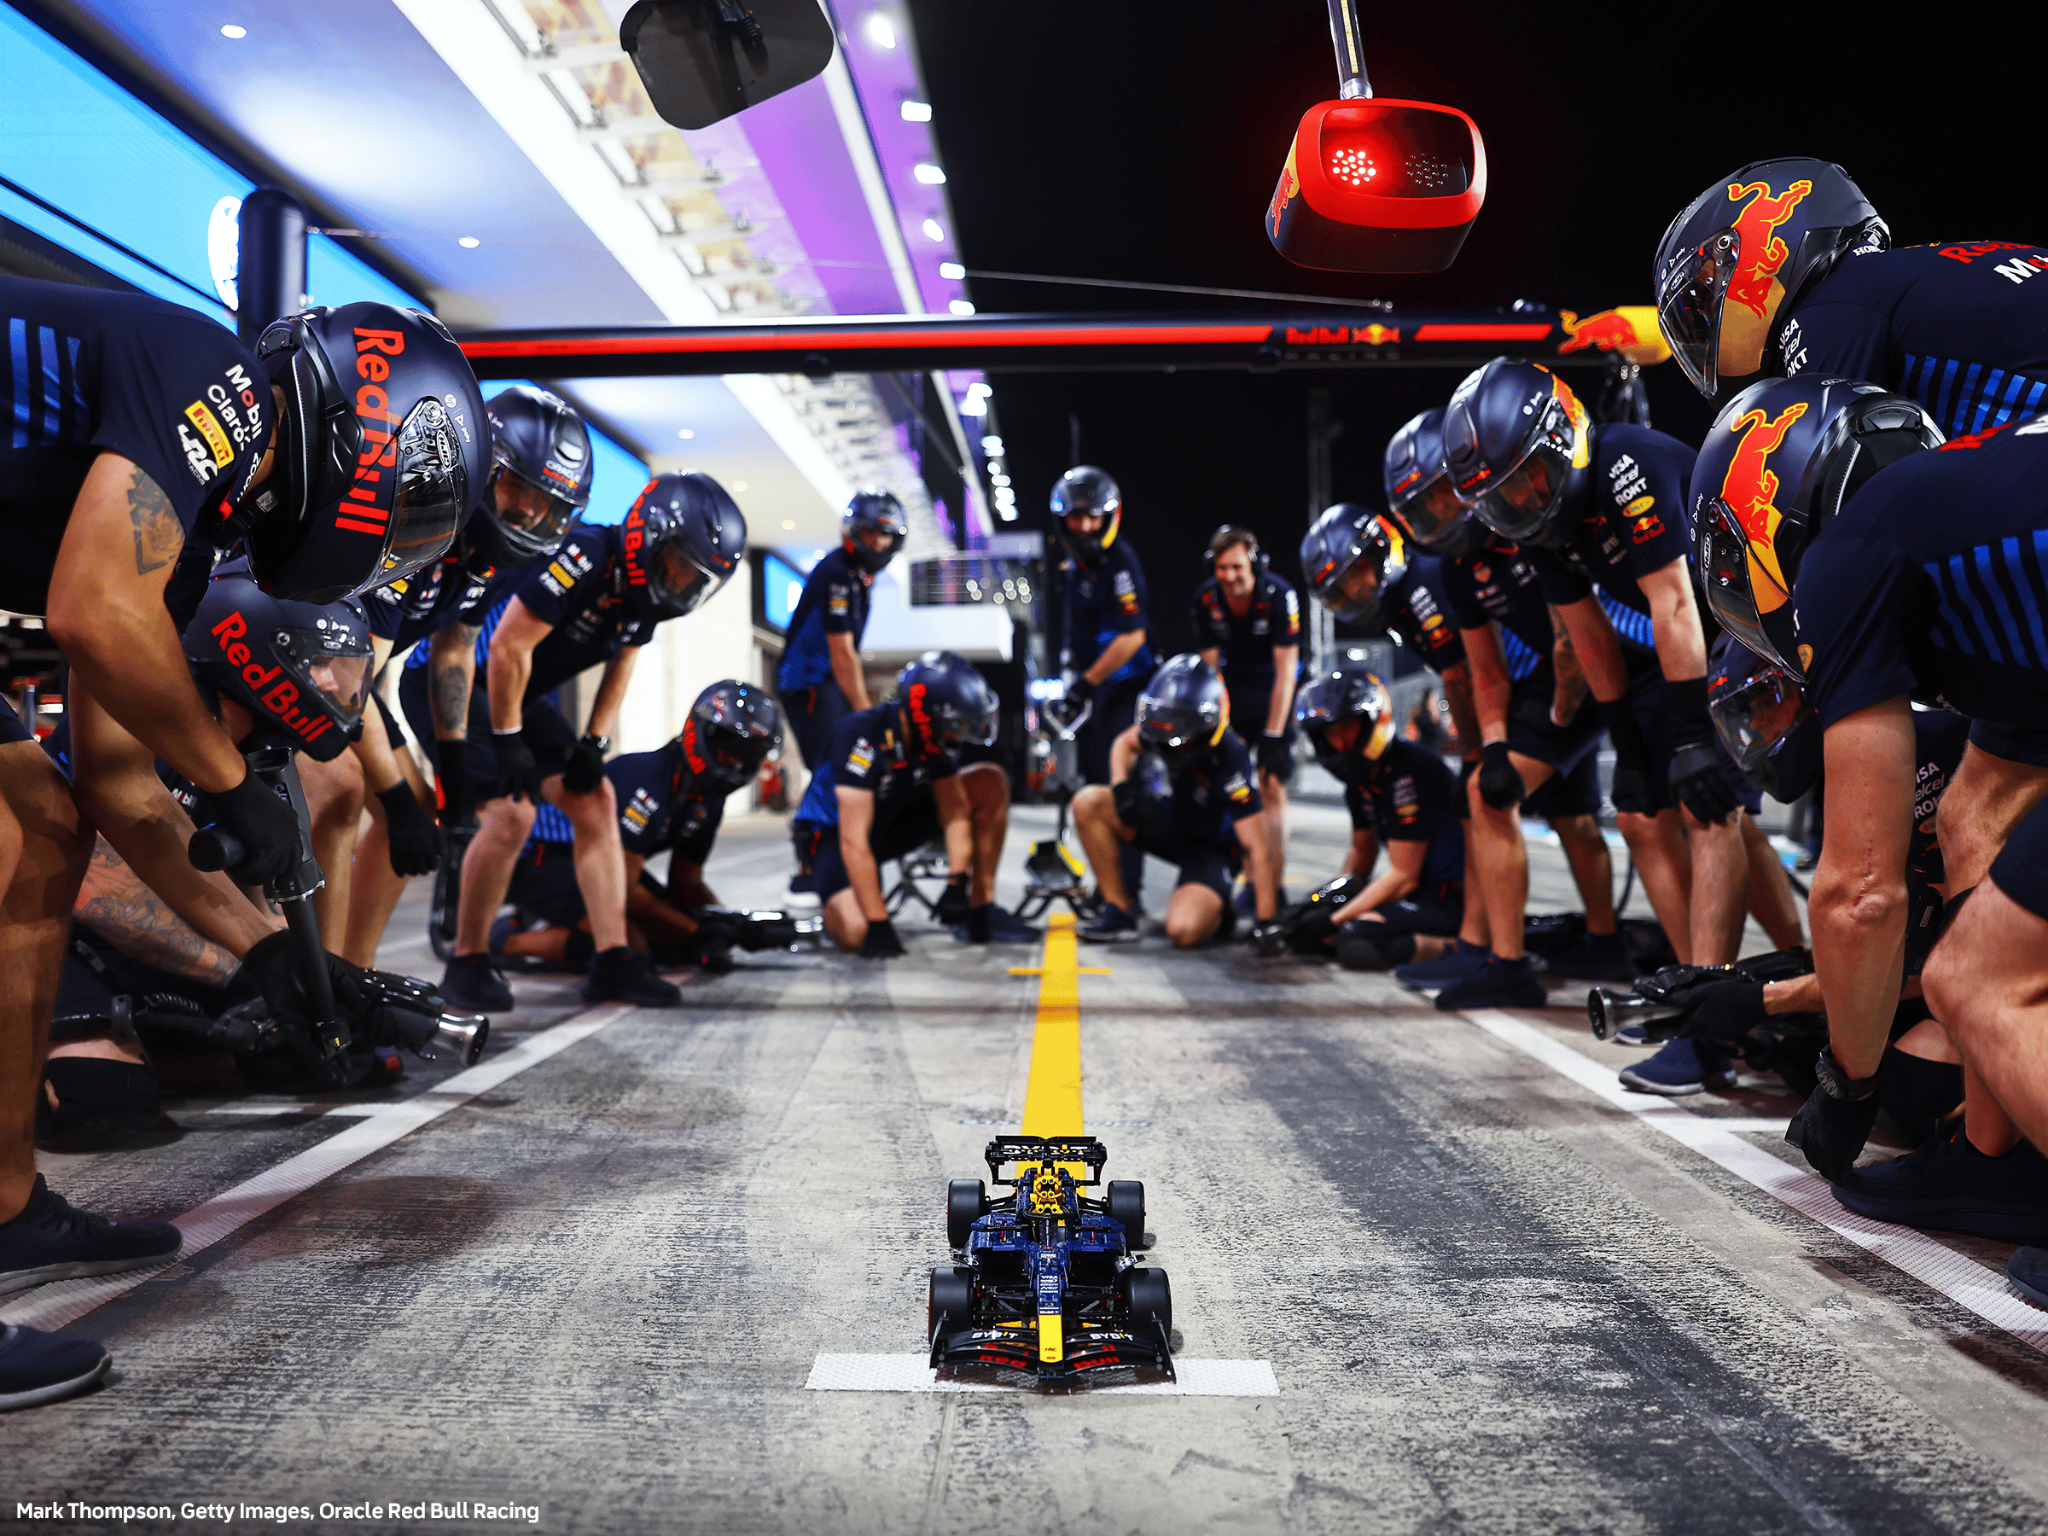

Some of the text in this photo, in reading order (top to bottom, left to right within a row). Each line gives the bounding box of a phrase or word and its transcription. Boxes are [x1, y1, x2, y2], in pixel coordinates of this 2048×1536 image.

[225, 363, 263, 440] Mobil
[353, 327, 406, 426] Red
[207, 384, 250, 452] Claro
[211, 611, 284, 692] Red
[260, 679, 335, 743] Bull
[1914, 773, 1946, 802] elcel
[1915, 762, 1941, 784] ISA
[1914, 796, 1939, 819] RO
